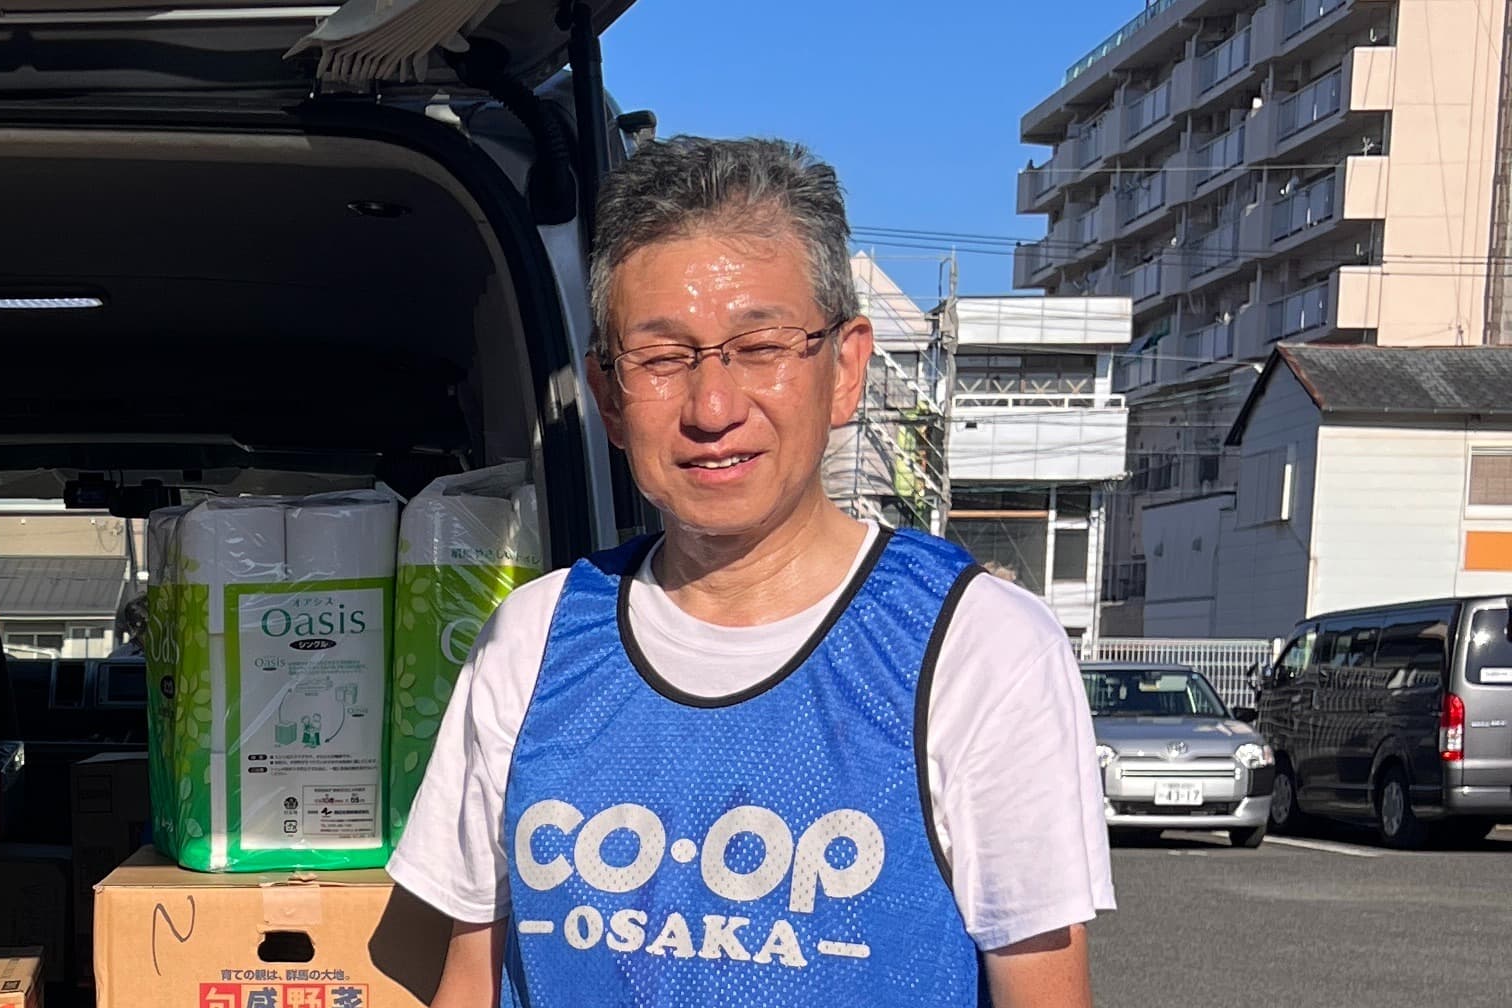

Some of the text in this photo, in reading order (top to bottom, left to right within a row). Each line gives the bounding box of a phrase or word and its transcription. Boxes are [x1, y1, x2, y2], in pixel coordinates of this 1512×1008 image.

[260, 604, 366, 637] Oasis
[254, 655, 286, 668] Oasis
[562, 904, 809, 968] OSAKA
